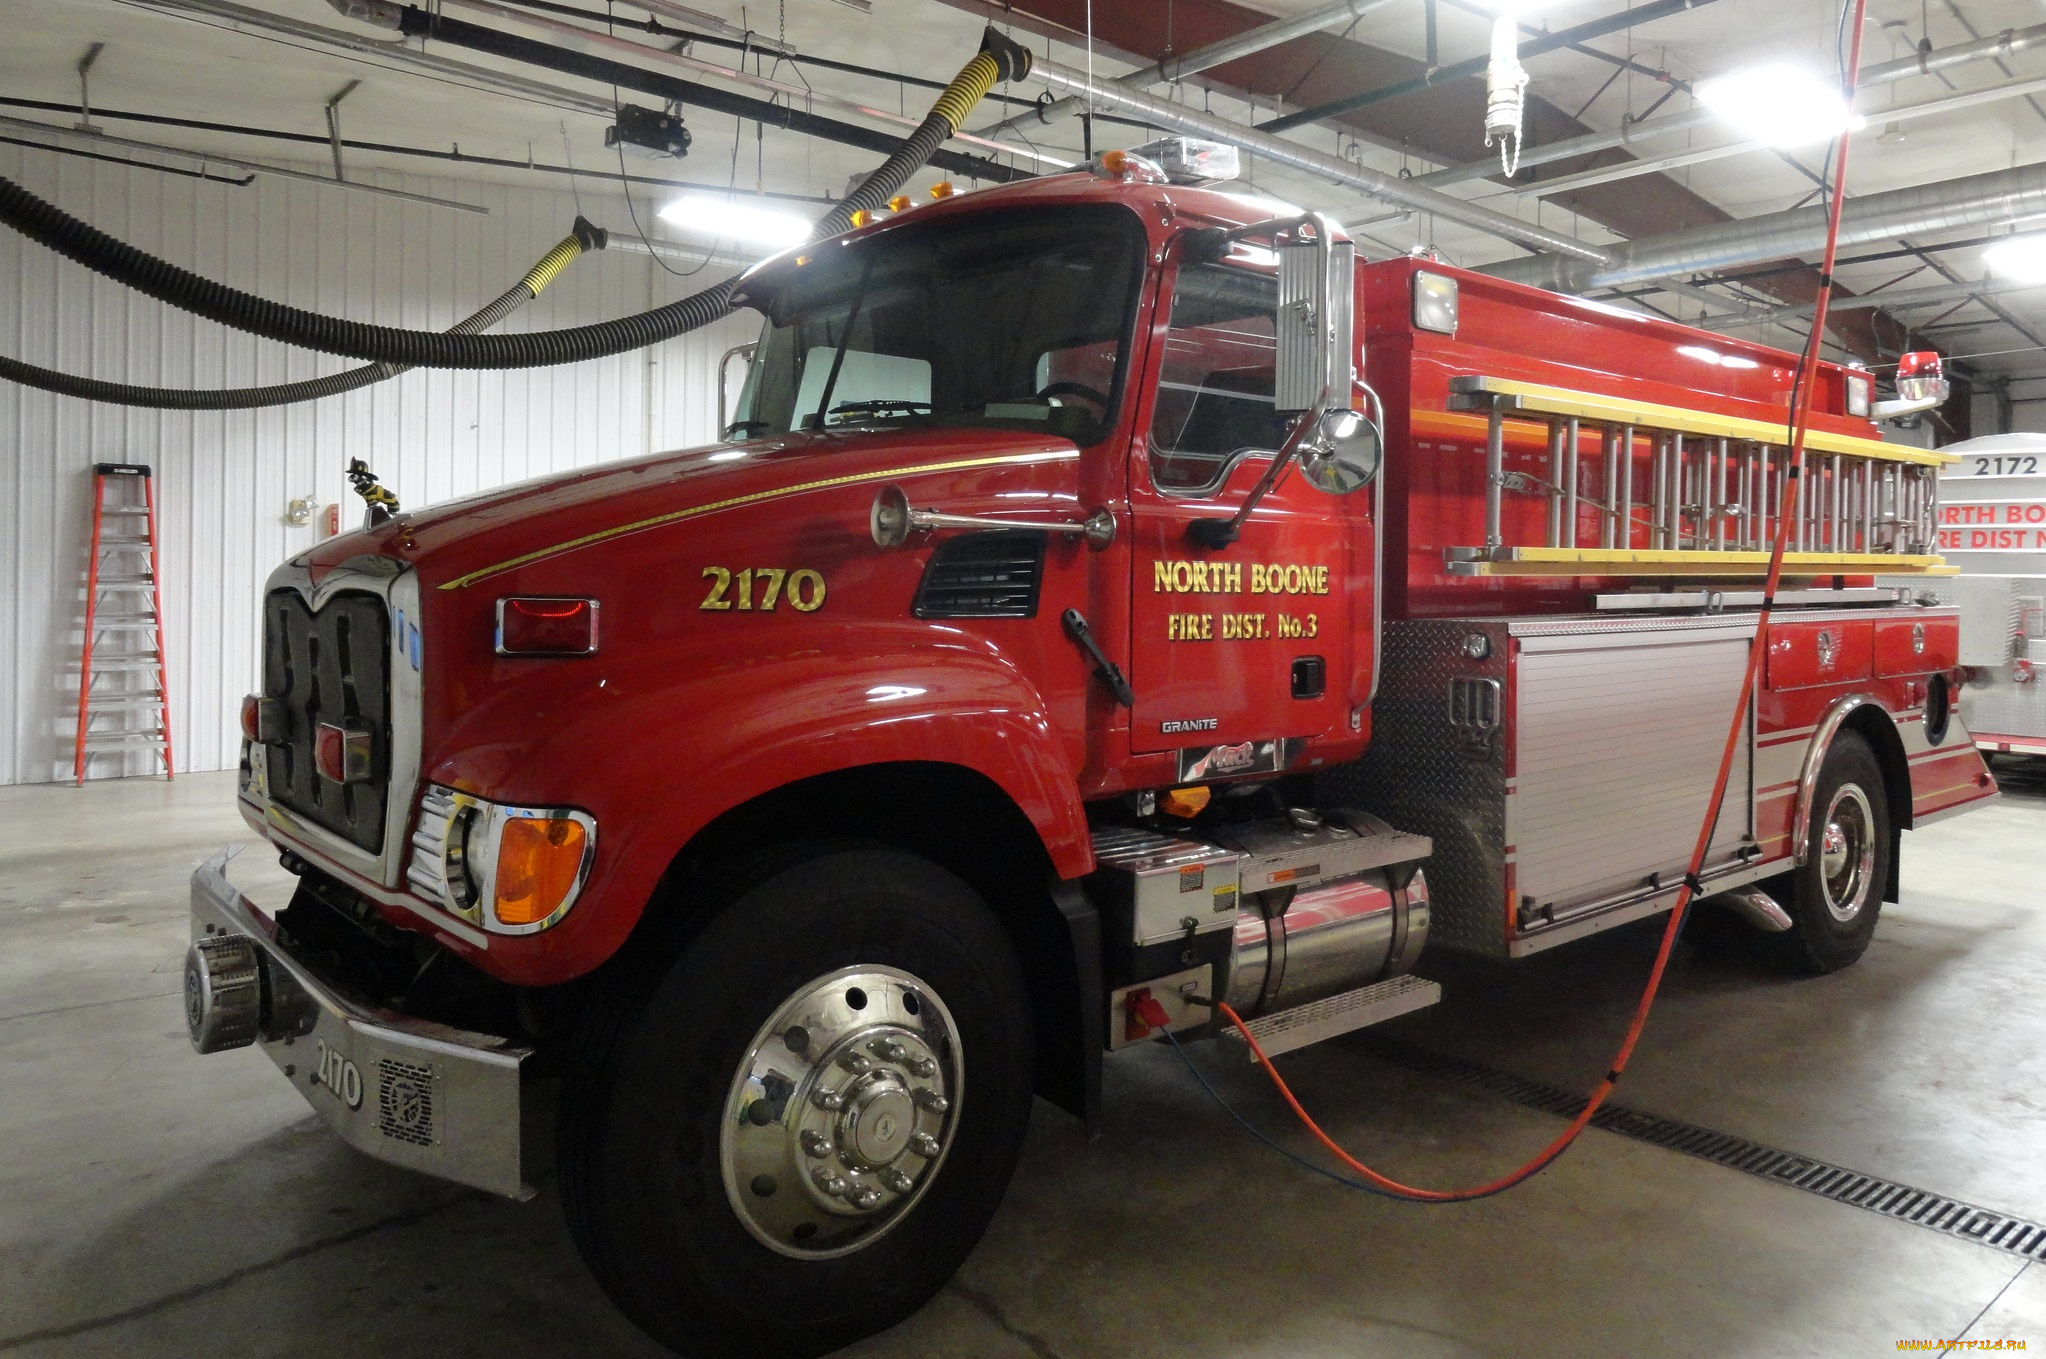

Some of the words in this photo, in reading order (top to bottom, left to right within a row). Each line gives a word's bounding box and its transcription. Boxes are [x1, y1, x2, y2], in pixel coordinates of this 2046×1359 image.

[1974, 456, 2038, 476] 2172
[1938, 504, 1996, 524] RTH
[1971, 530, 2027, 549] DIST
[699, 566, 827, 612] 2170
[1153, 560, 1242, 593] NORTH
[1250, 563, 1329, 594] BOONE
[1167, 613, 1213, 640] FIRE
[1222, 613, 1270, 639] DIST.
[1277, 613, 1318, 638] No.3
[317, 1037, 363, 1109] 2170
